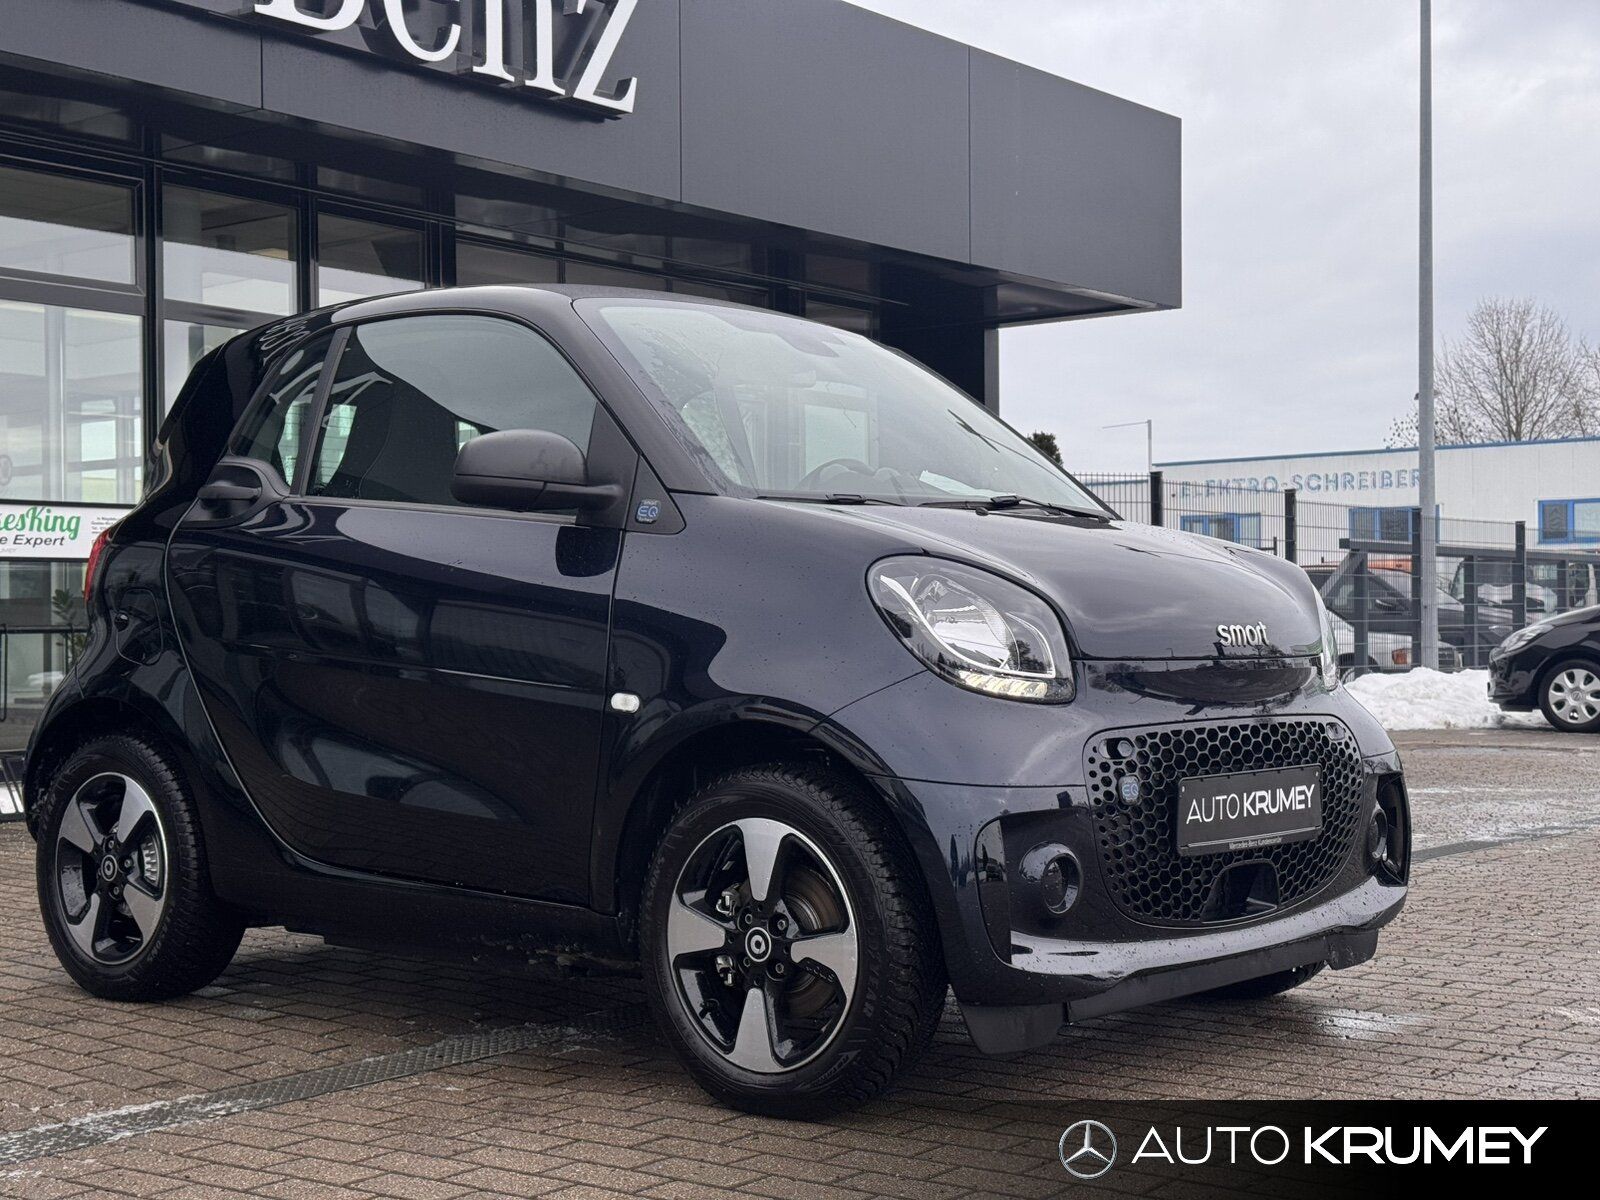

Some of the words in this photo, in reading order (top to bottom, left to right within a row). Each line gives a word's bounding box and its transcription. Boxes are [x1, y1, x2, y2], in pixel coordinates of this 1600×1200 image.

[254, 0, 638, 113] enz
[0, 506, 81, 541] esKing
[637, 505, 659, 518] EQ
[13, 534, 66, 548] Expert
[1217, 621, 1270, 647] smart
[1186, 793, 1240, 824] AUTO
[1243, 784, 1315, 817] KRUMEY
